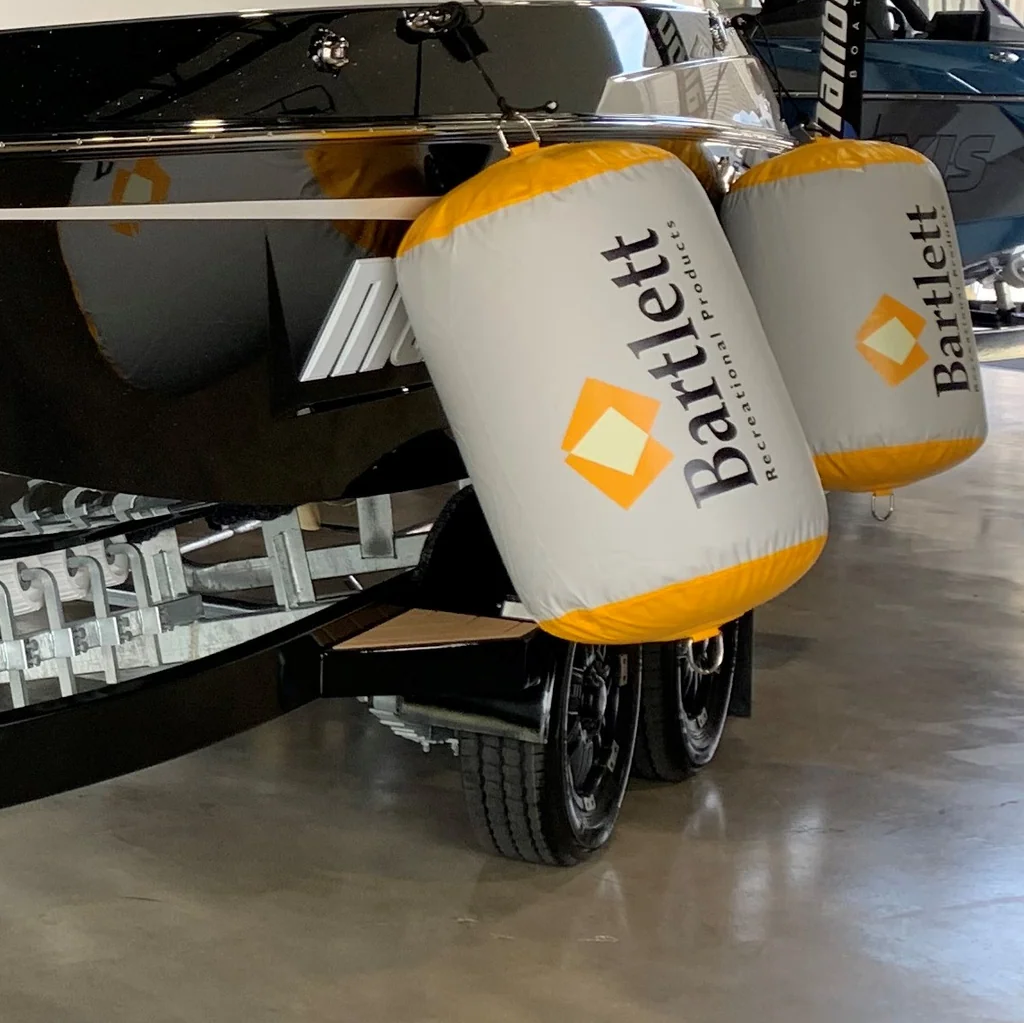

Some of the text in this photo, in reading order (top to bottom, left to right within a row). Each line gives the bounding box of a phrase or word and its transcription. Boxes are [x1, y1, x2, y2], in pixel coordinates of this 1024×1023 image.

[599, 226, 756, 509] Bartlett
[666, 219, 778, 481] Recreational Products
[906, 204, 972, 398] Bartlett
